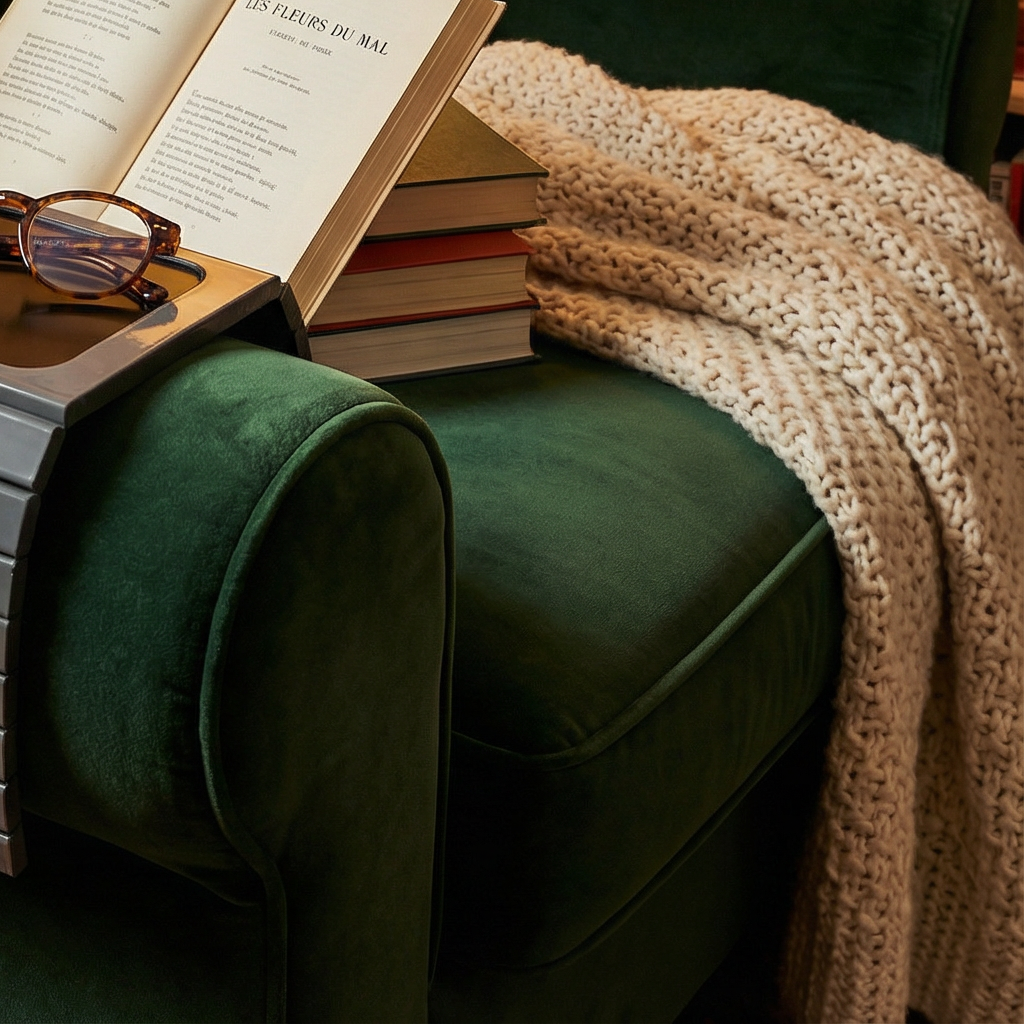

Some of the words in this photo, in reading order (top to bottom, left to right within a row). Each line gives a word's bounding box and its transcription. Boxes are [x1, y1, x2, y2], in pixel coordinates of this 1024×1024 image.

[272, 2, 328, 32] FLEURS
[330, 23, 355, 41] DU
[356, 33, 389, 56] MAL
